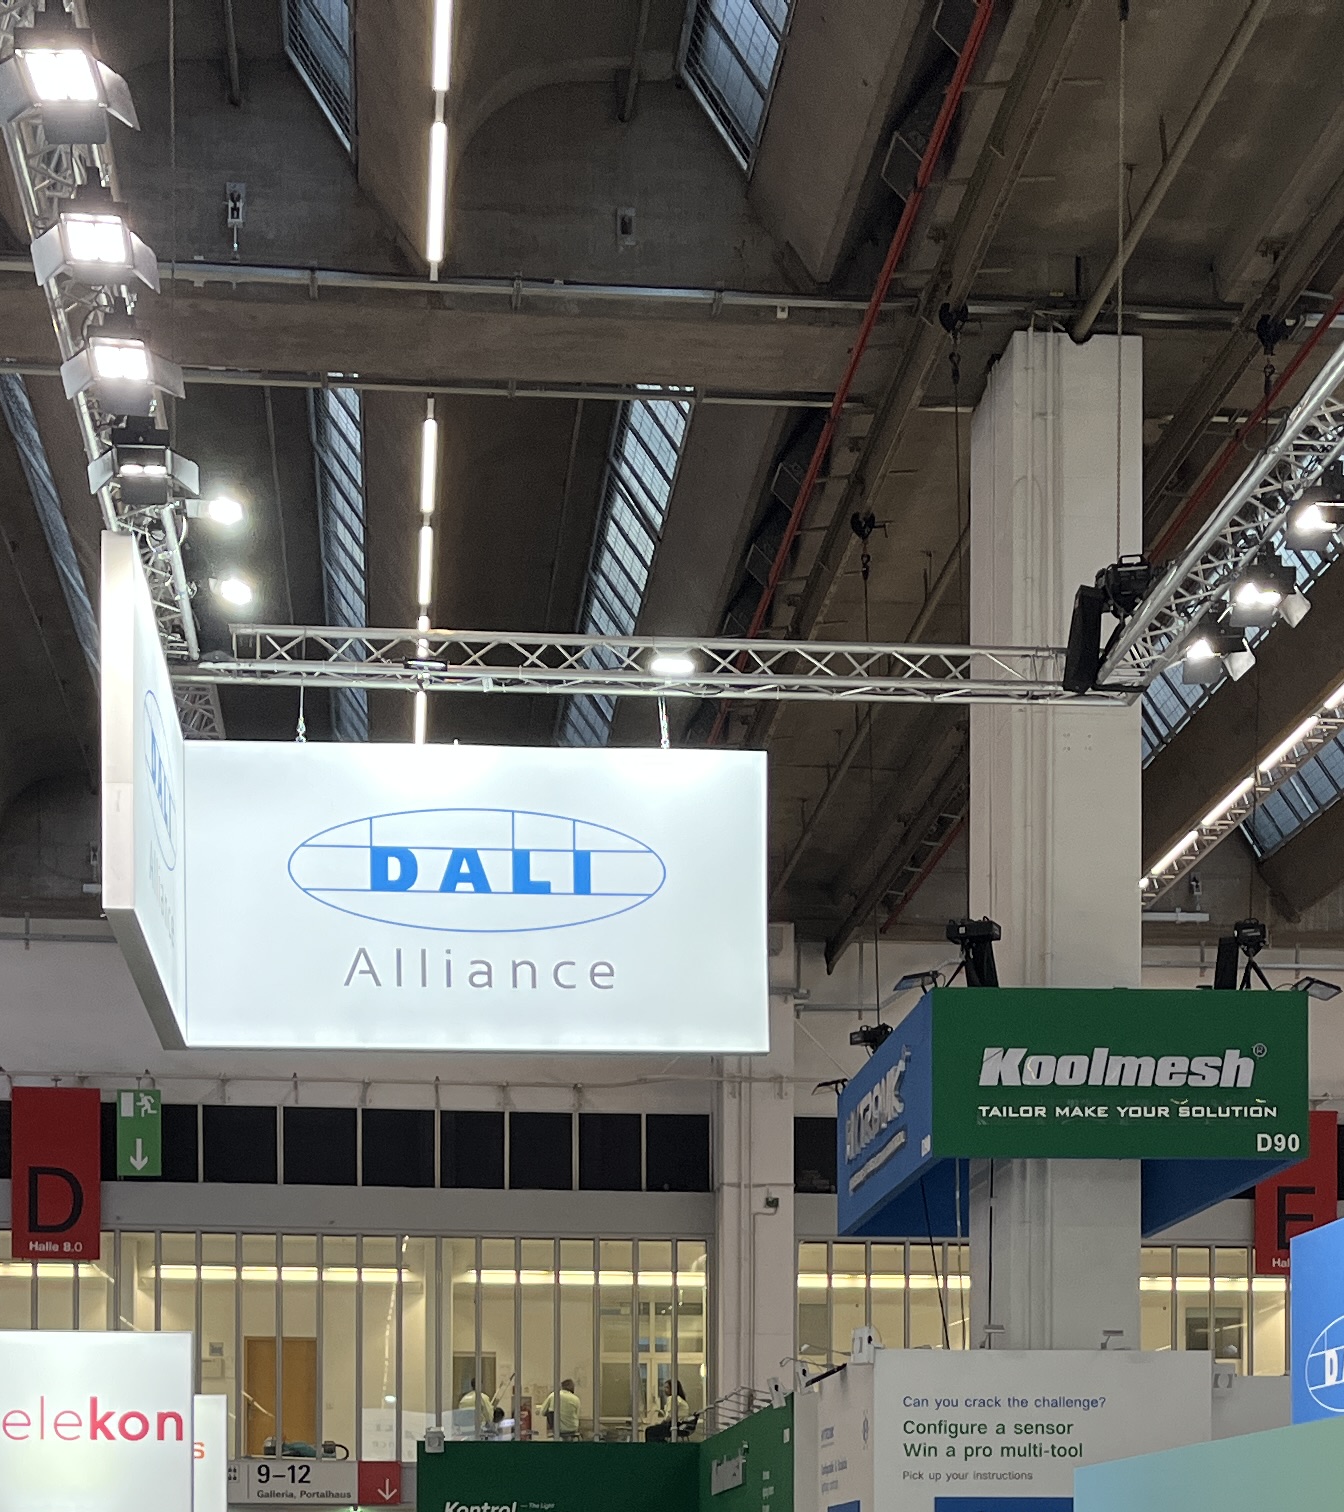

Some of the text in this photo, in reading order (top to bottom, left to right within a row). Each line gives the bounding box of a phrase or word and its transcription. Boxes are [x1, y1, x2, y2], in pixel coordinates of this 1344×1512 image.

[370, 847, 591, 895] DALI
[344, 948, 614, 989] Alliance
[978, 1106, 1276, 1117] TAILOR MAKE YOUR SOLUTION
[1257, 1134, 1299, 1151] D90
[28, 1166, 83, 1233] D
[1278, 1186, 1315, 1250] E
[29, 1241, 59, 1251] Halle
[1272, 1257, 1290, 1267] Hal
[903, 1396, 1106, 1411] Can you crack the challenge?
[3, 1396, 183, 1441] elekon
[904, 1420, 1073, 1438] Configure a sensor
[903, 1443, 1082, 1461] Win a pro multi-tool
[903, 1471, 1033, 1482] Pick up your instructions
[300, 1490, 351, 1498] Portalhaus
